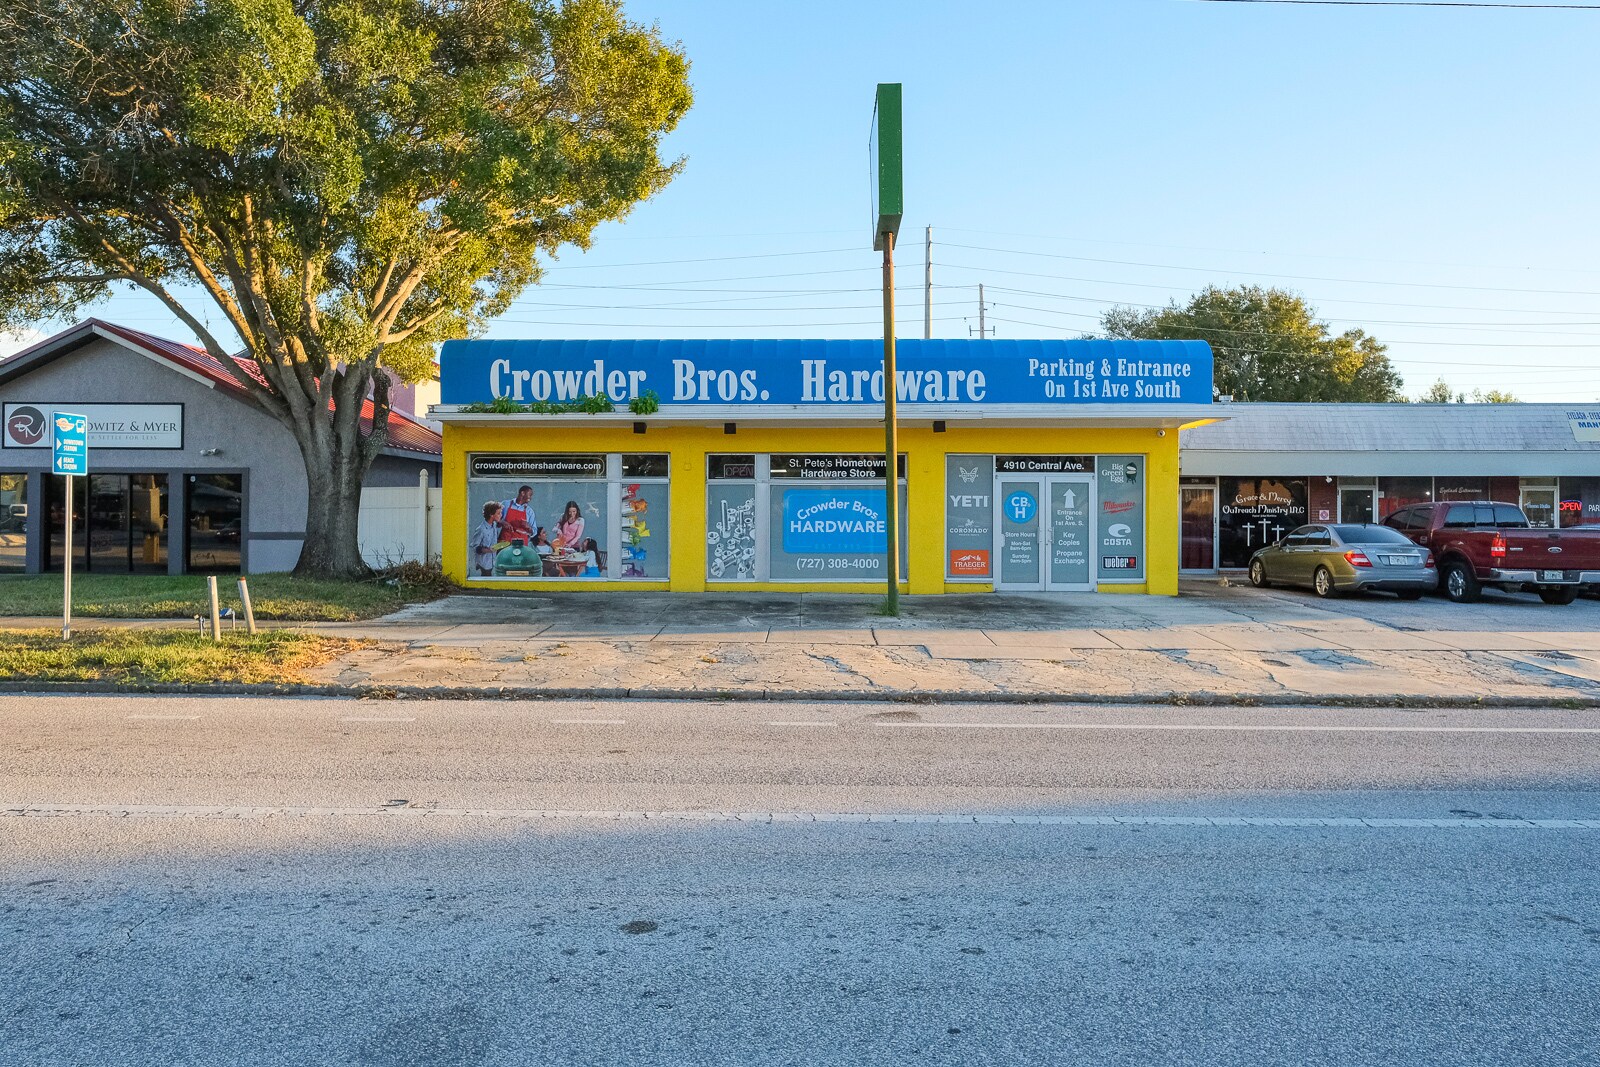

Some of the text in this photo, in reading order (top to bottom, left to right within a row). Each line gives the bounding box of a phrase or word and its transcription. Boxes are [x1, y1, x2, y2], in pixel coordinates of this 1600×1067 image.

[1028, 359, 1192, 379] Parking & Entrance
[489, 359, 987, 402] Crowder Bros. Hardware
[1044, 379, 1182, 399] On 1st Ave South
[129, 421, 140, 432] &
[143, 421, 178, 432] MYER
[475, 461, 601, 470] crowderbrothershardware.com
[789, 459, 887, 467] St. Pete's Hometown
[1003, 461, 1085, 470] 4910 Central Ave.
[1112, 463, 1124, 471] Big
[725, 466, 753, 477] OPEN
[800, 469, 876, 478] Hardware Store
[950, 495, 989, 508] YETI
[1235, 492, 1292, 506] Grace & Mercy
[797, 498, 850, 520] Crowder
[1222, 505, 1257, 514] Outreach
[1258, 504, 1289, 516] Ministry
[1559, 502, 1582, 511] OPEN
[790, 520, 886, 533] HARDWARE
[1062, 531, 1076, 540] Key
[1103, 538, 1132, 546] COSTA
[1056, 550, 1083, 558] Propane
[796, 558, 879, 571] (727) 308-4000
[1054, 557, 1086, 566] Exchange
[1104, 555, 1129, 568] weber
